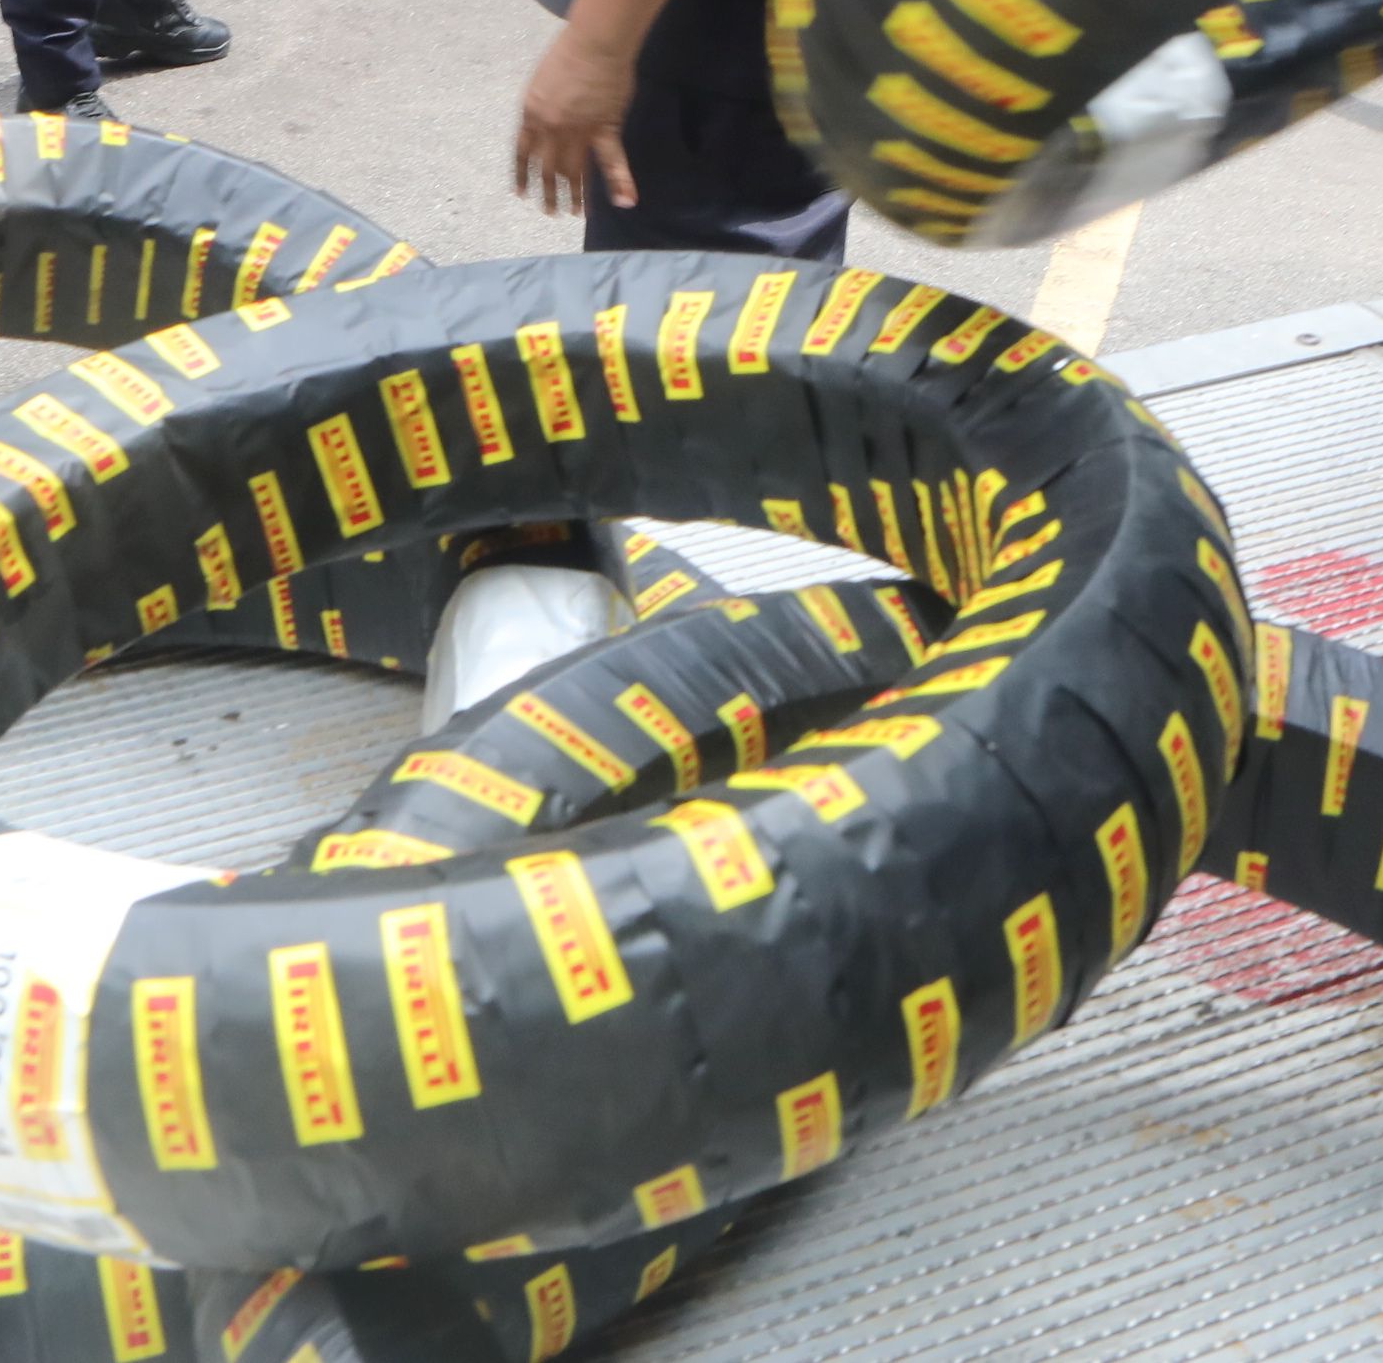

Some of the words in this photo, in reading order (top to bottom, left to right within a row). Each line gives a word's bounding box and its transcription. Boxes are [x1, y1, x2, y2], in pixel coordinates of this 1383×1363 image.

[736, 279, 786, 365] PIRELLI
[389, 381, 439, 479] PIRELLI
[455, 356, 501, 455] PIRELLI
[525, 333, 573, 435] PIRELLI
[320, 426, 373, 526] PIRELLI
[408, 757, 529, 813] PIRELLI
[288, 962, 344, 1126] PIRELLI
[399, 921, 460, 1088] PIRELLI
[19, 982, 59, 1147] PIRELLI
[146, 995, 199, 1155] PIRELLI
